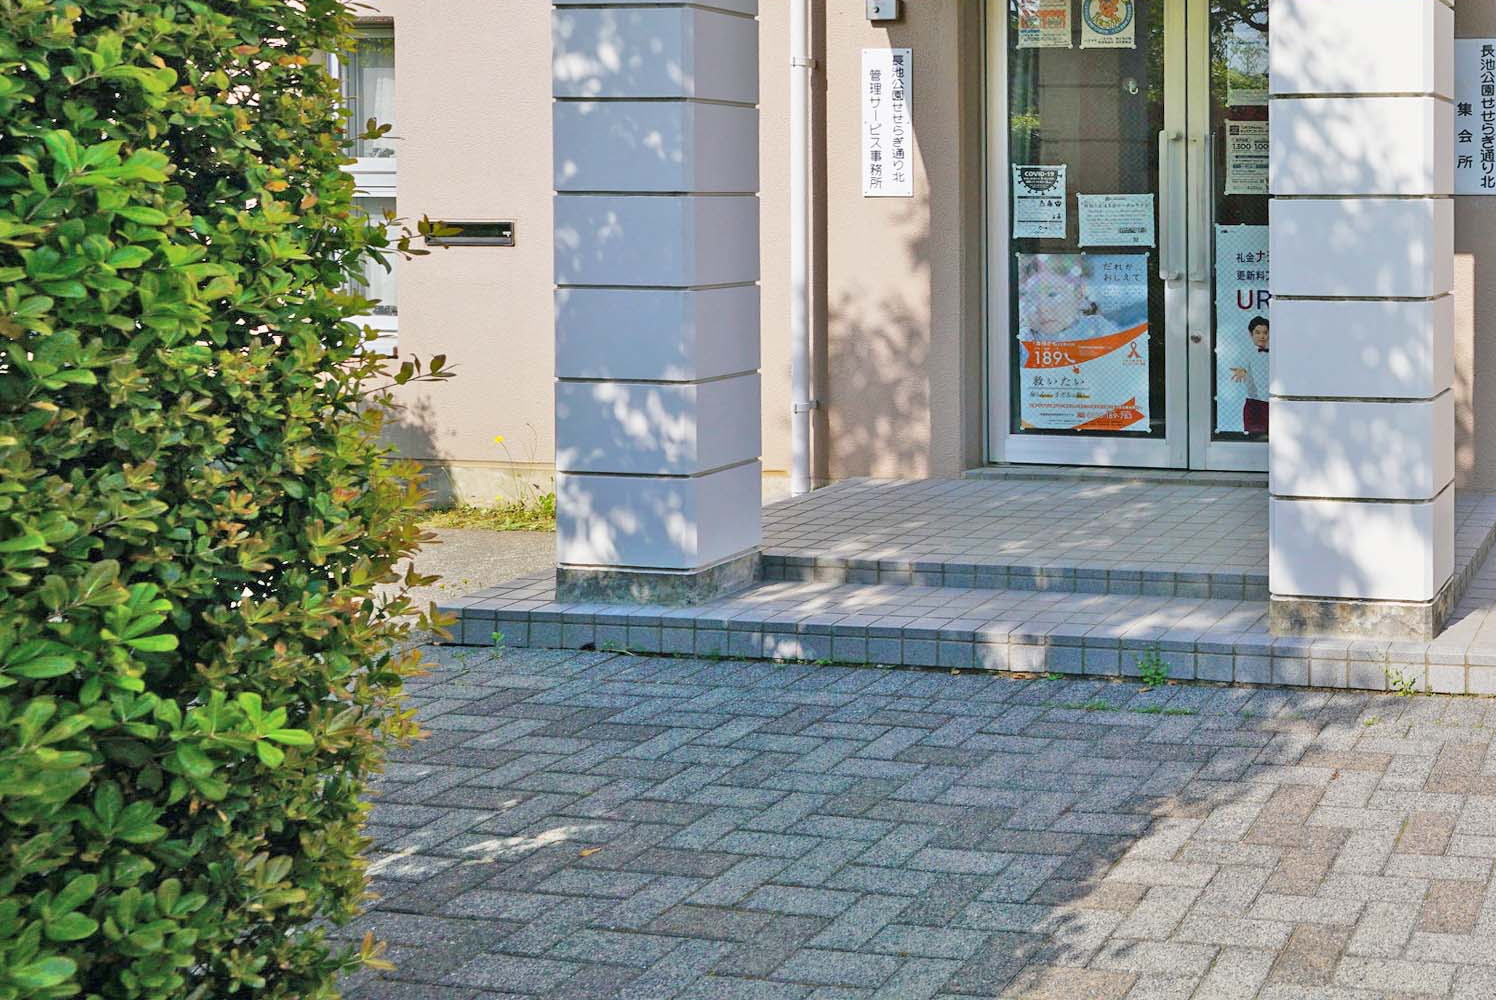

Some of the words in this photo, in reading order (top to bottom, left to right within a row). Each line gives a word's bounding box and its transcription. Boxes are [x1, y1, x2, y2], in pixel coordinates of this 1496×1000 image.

[869, 69, 882, 190] 管理サービス事務所
[892, 54, 905, 183] 長池公園せせらぎ通り北
[1457, 101, 1473, 169] 集会所
[1480, 43, 1496, 189] 長池公園せせらぎ通り北
[1103, 273, 1140, 281] おしえて
[1237, 289, 1270, 310] UR
[1034, 350, 1063, 365] 189
[1032, 375, 1085, 386] 救いたい
